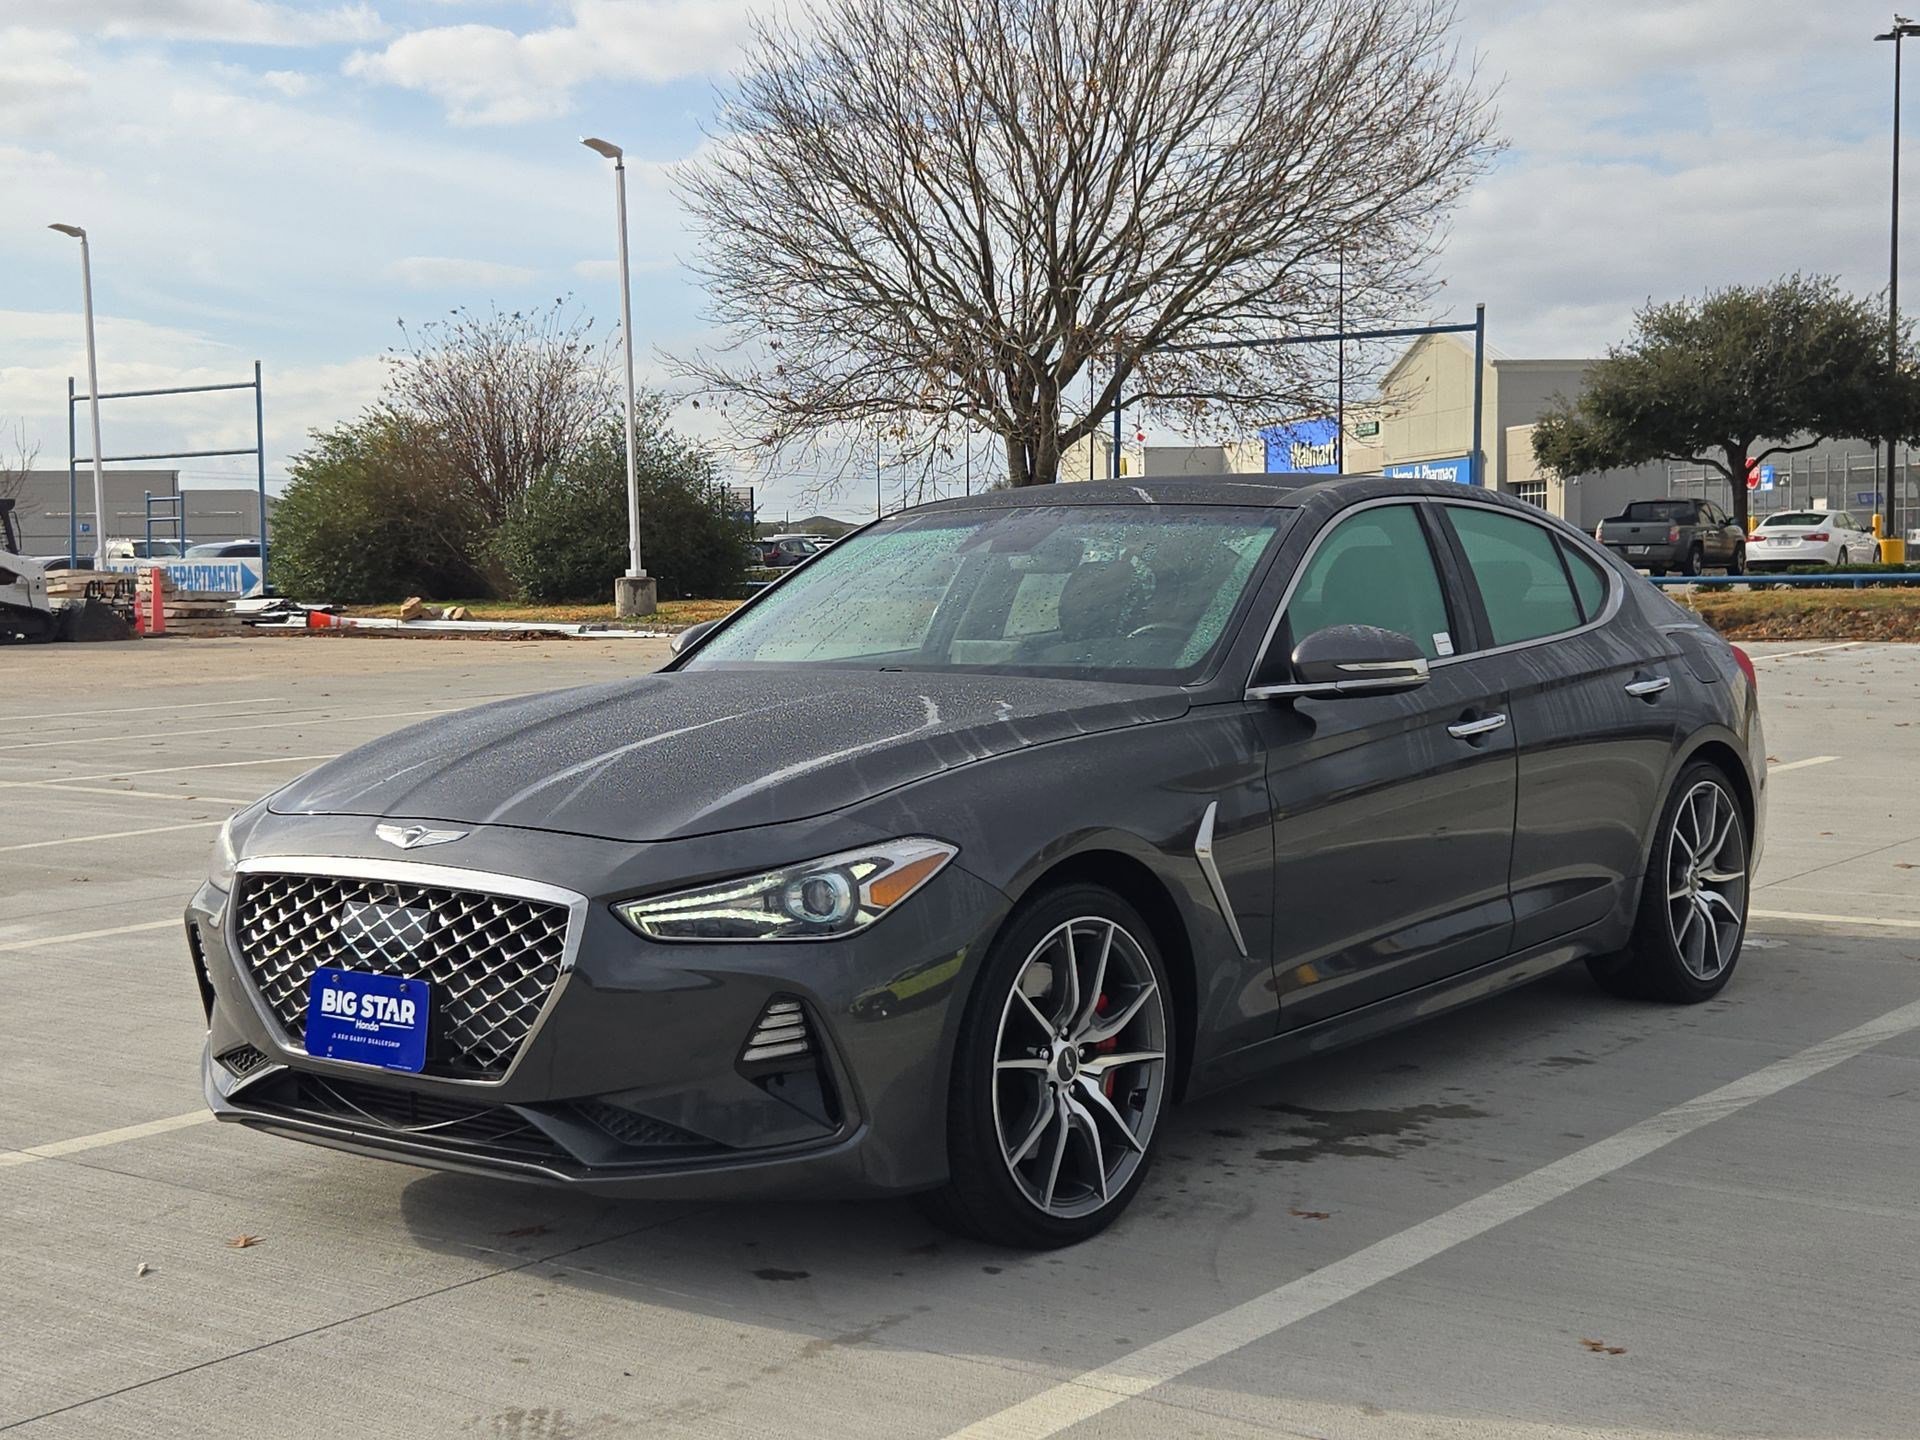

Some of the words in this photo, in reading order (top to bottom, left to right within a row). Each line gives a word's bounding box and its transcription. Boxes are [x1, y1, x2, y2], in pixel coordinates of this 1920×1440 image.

[1291, 437, 1336, 469] Walmart
[1422, 465, 1458, 482] Pharmacy
[321, 988, 357, 1016] BIG
[360, 994, 415, 1024] STAR
[355, 1019, 379, 1032] Honda
